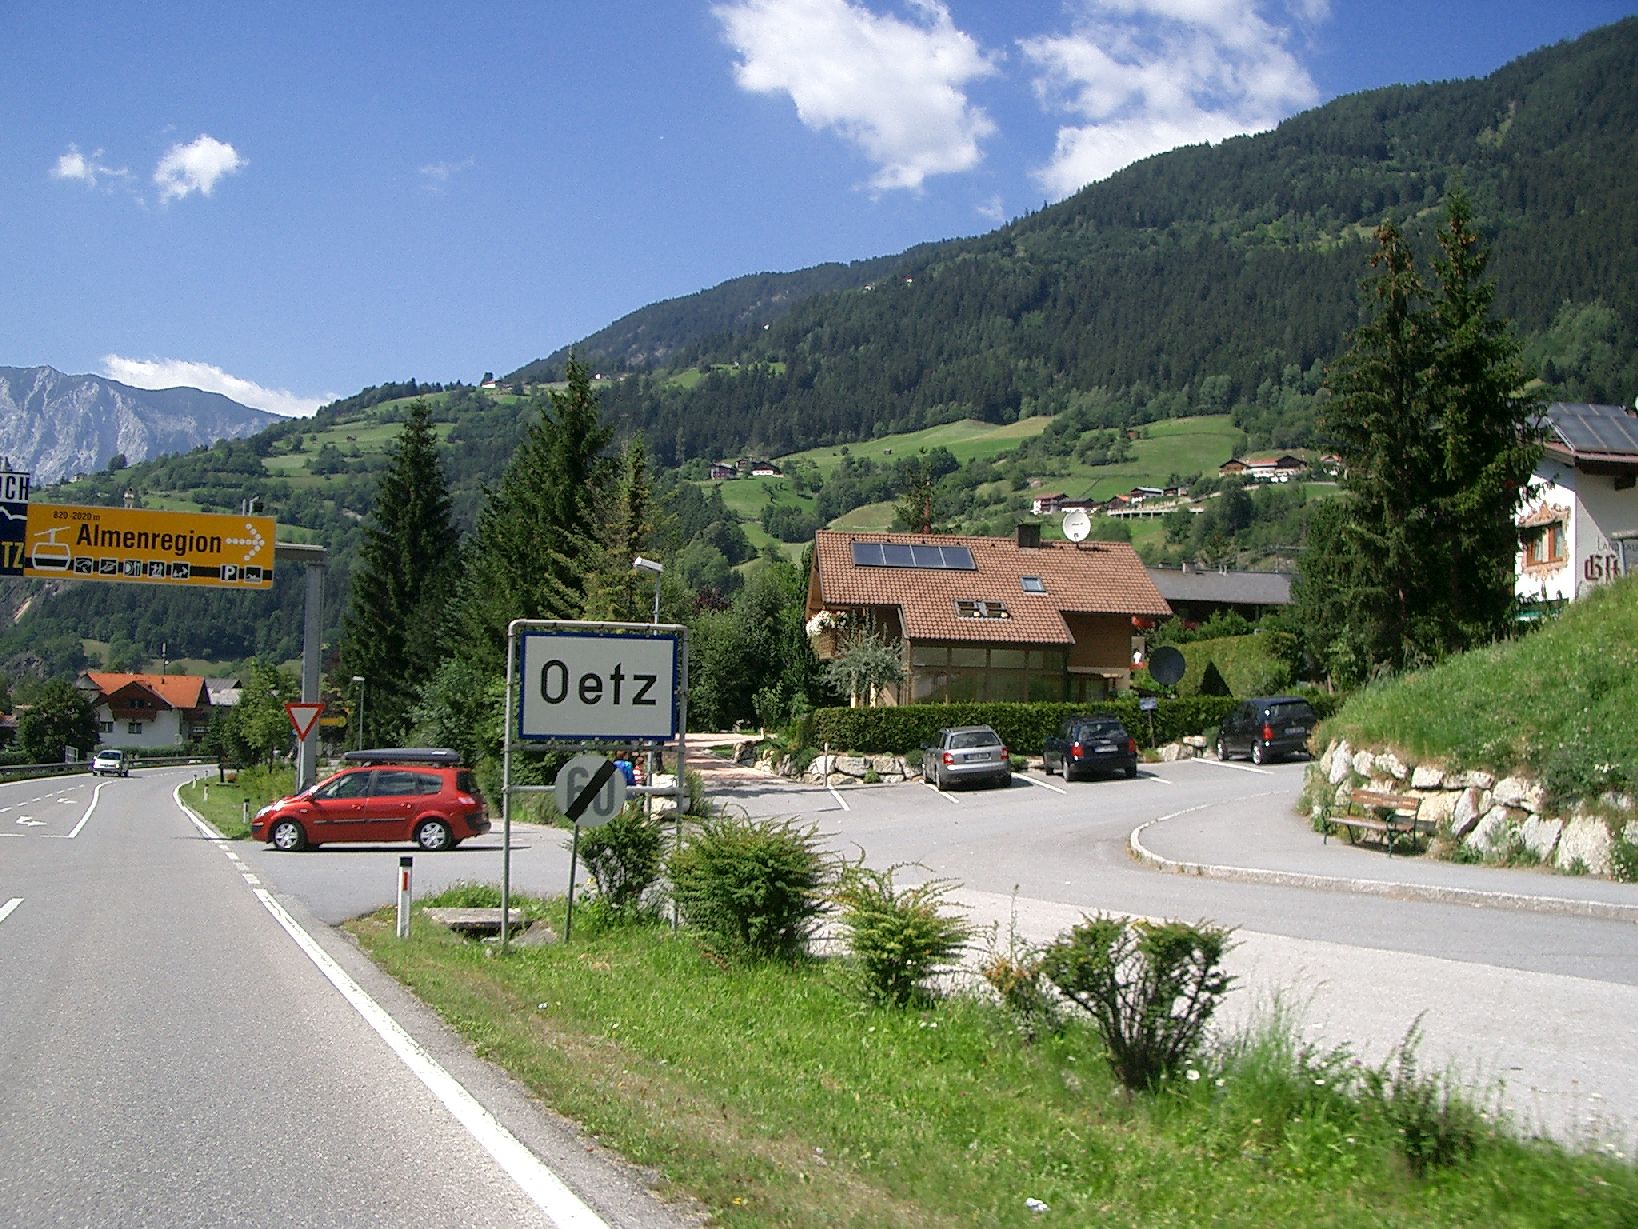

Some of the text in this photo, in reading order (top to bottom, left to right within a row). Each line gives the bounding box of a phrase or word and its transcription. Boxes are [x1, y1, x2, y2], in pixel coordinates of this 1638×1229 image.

[0, 475, 29, 501] CH
[76, 523, 222, 556] Almenregion
[540, 659, 657, 706] Oetz
[567, 767, 615, 817] 60
